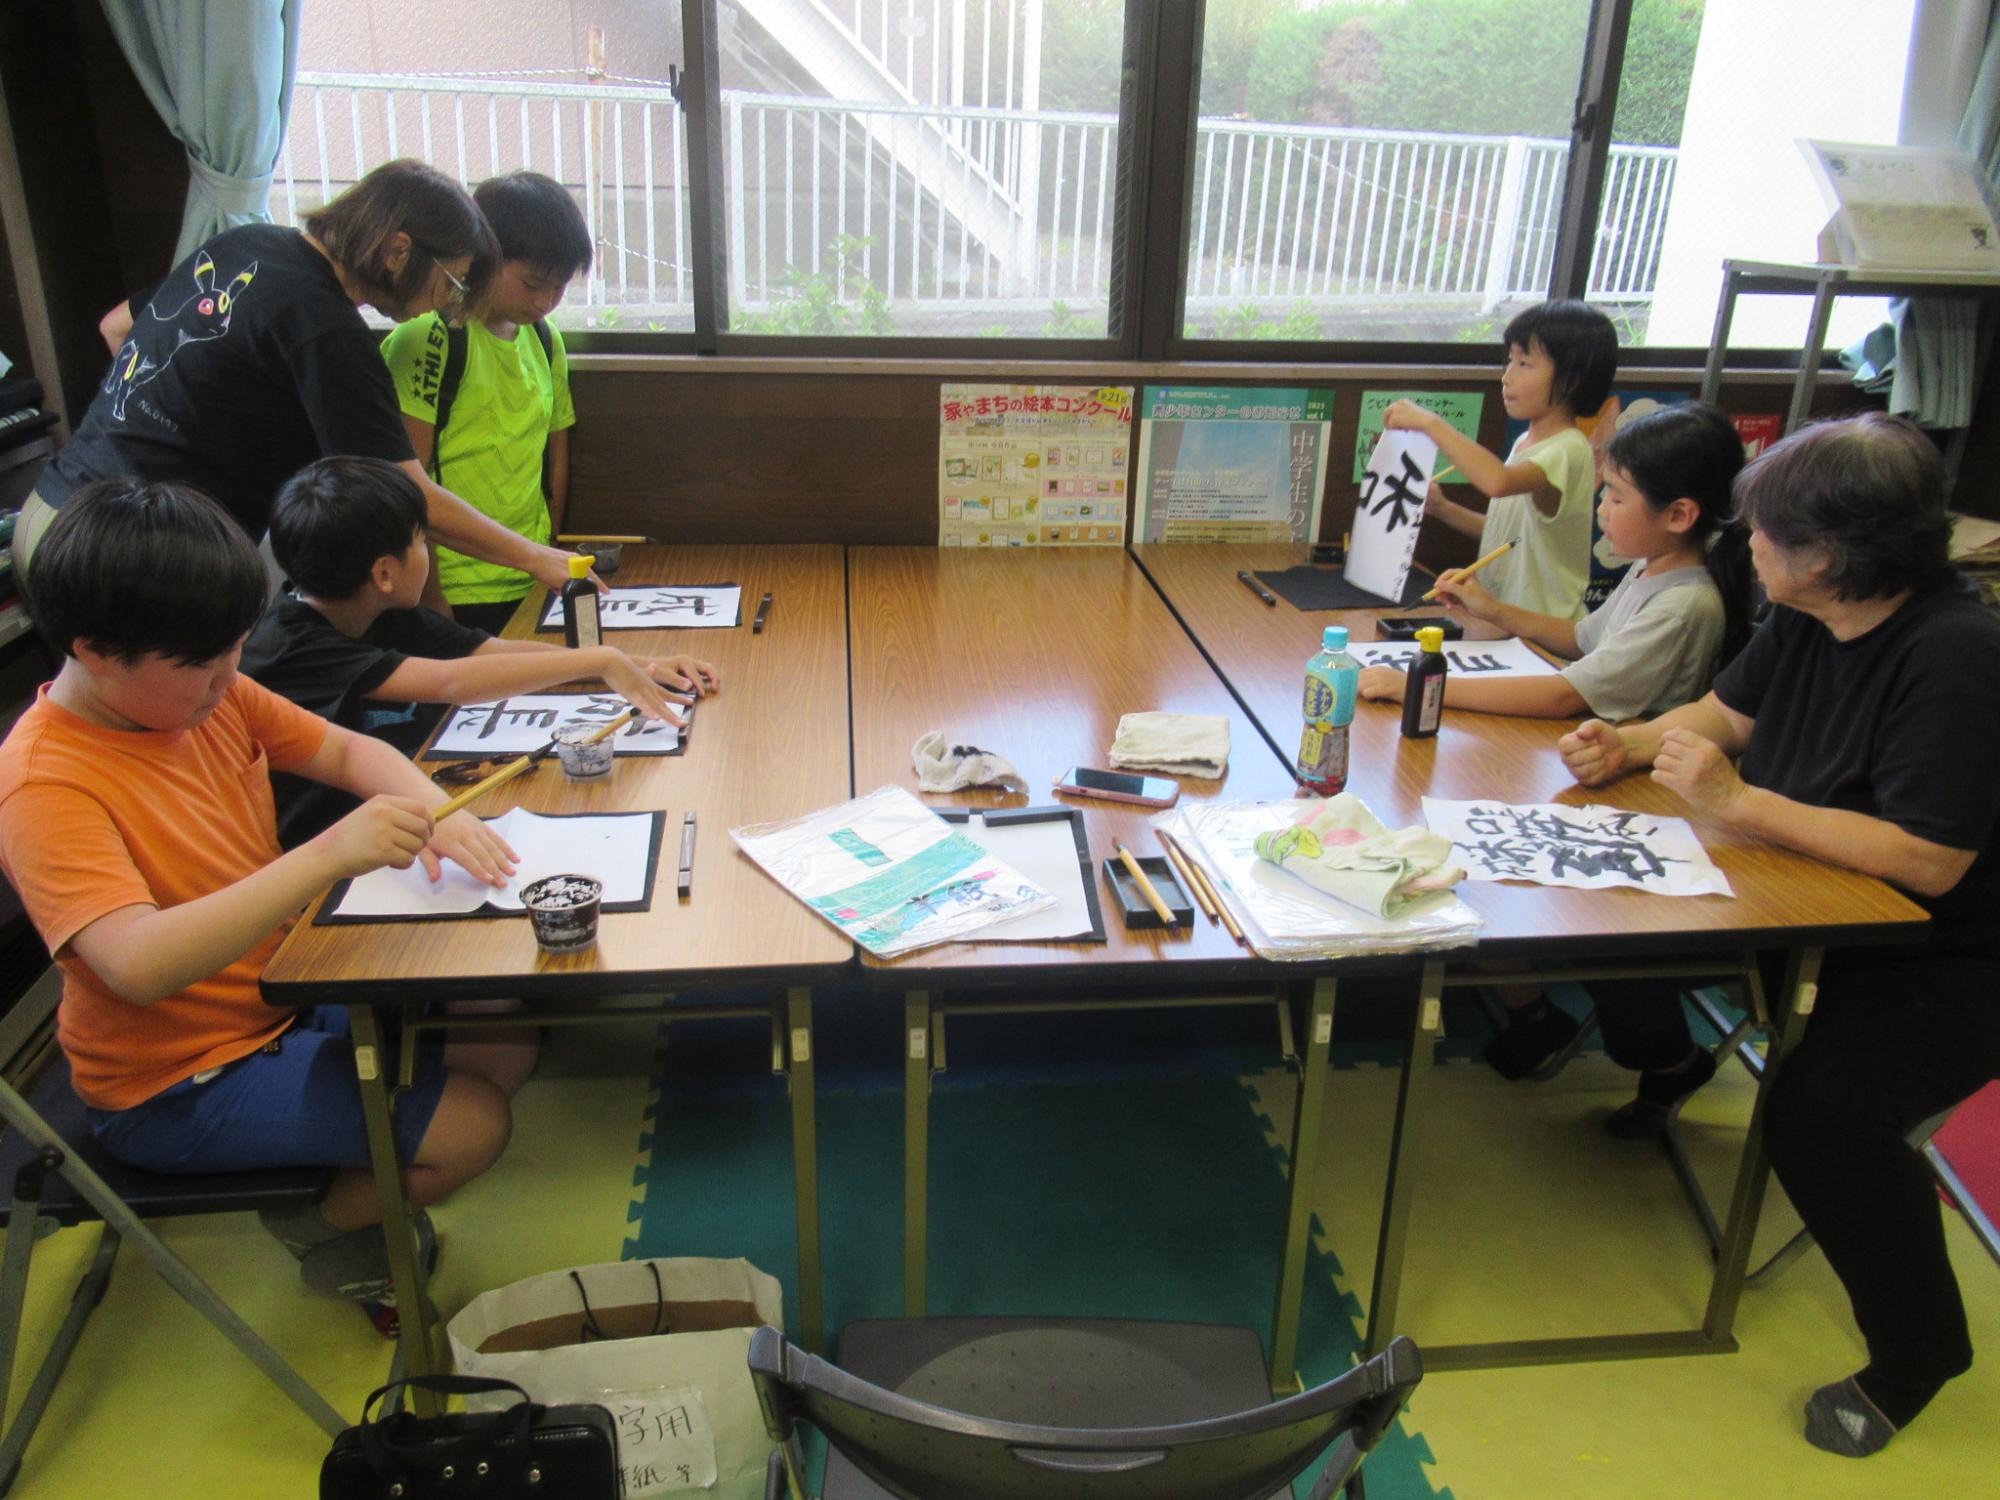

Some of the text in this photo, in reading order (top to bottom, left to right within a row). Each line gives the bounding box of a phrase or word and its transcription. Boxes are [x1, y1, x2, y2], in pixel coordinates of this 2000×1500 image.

[943, 395, 1132, 423] 家やまちの絵本コンクール
